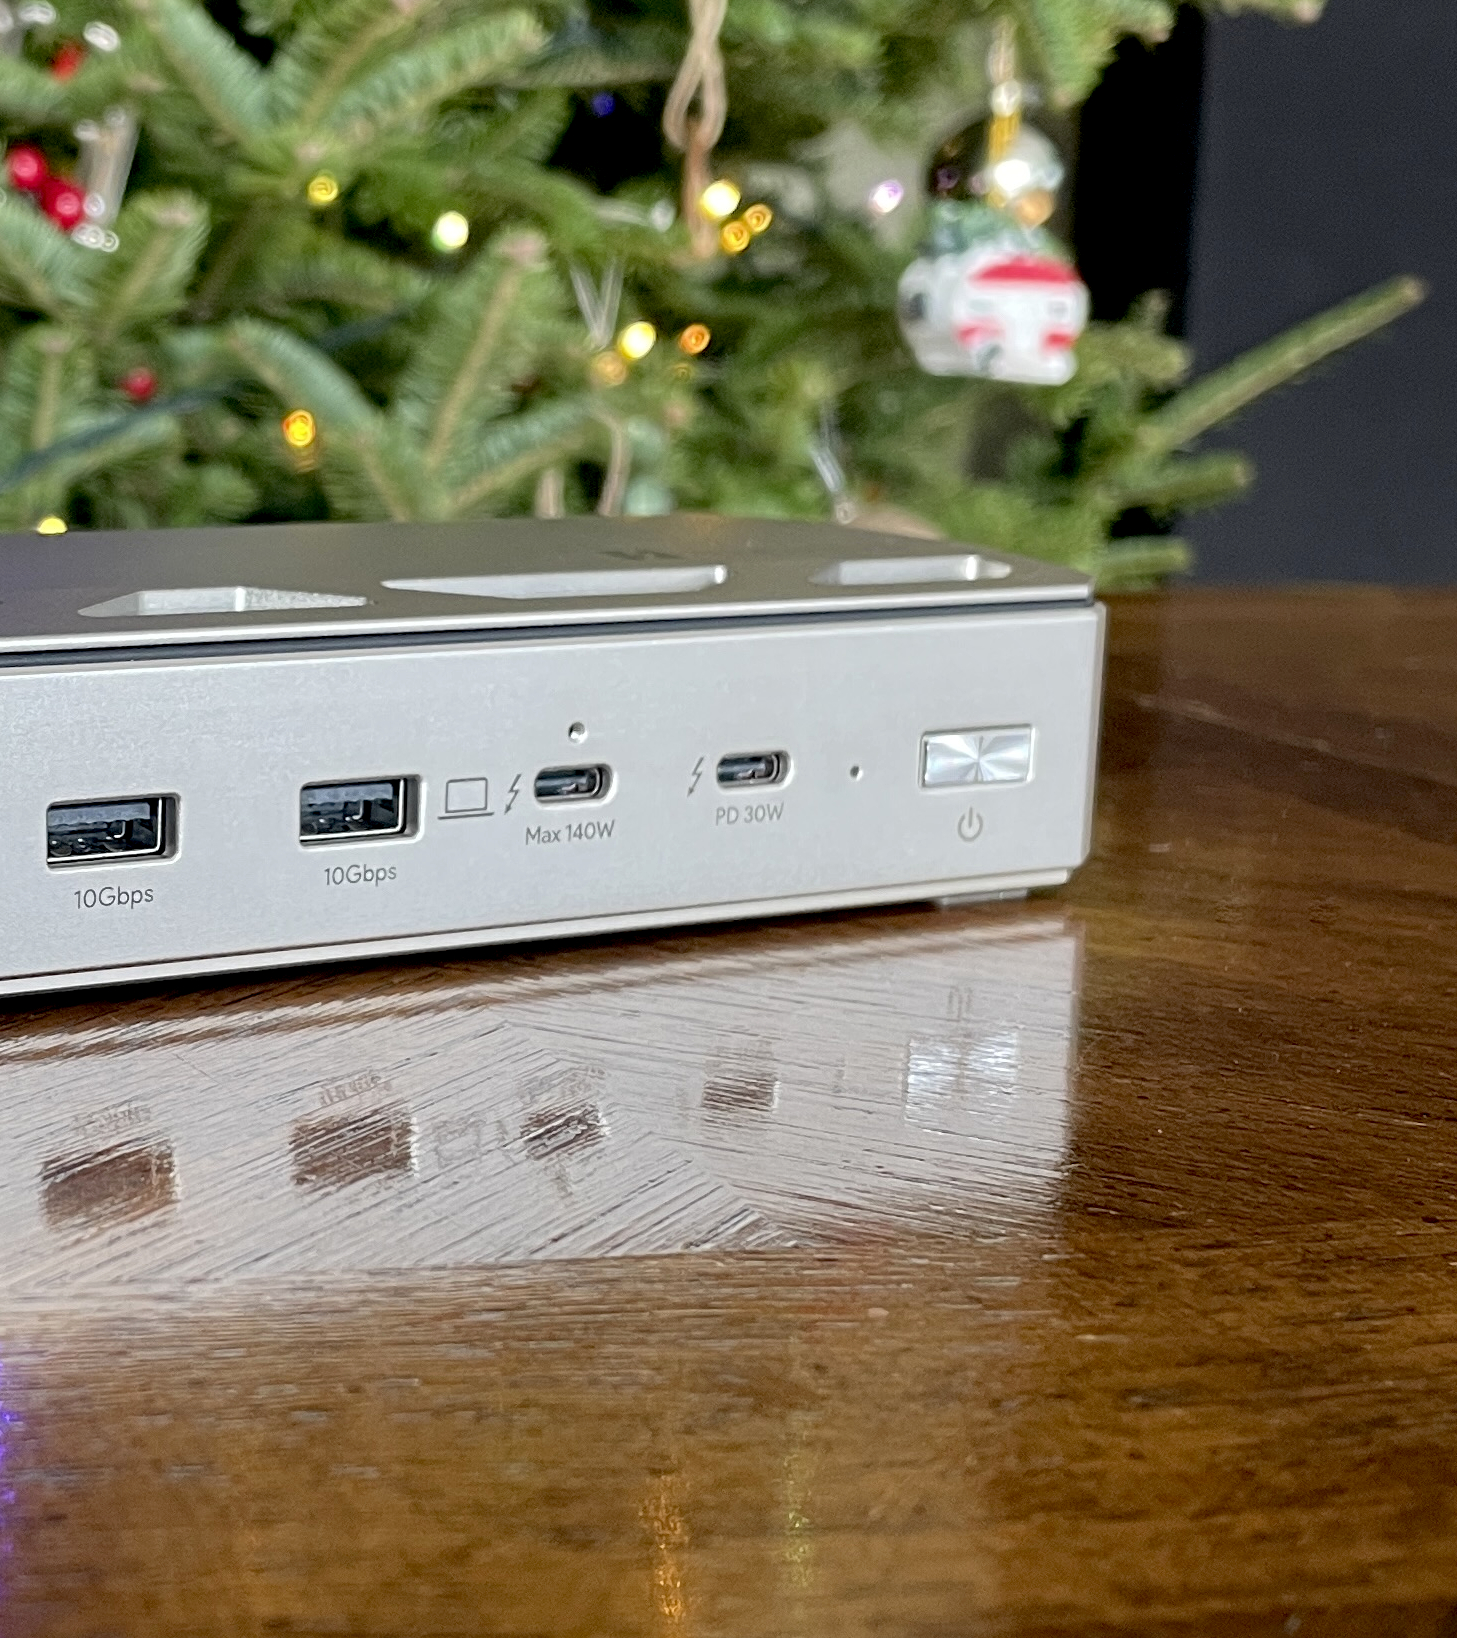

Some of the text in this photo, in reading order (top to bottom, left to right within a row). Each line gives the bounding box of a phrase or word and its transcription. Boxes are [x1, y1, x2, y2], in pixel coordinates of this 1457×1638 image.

[715, 803, 784, 826] PD 30W
[525, 820, 616, 846] Max 140W
[324, 863, 398, 887] 10Gbps
[74, 885, 155, 910] 10Gbps
